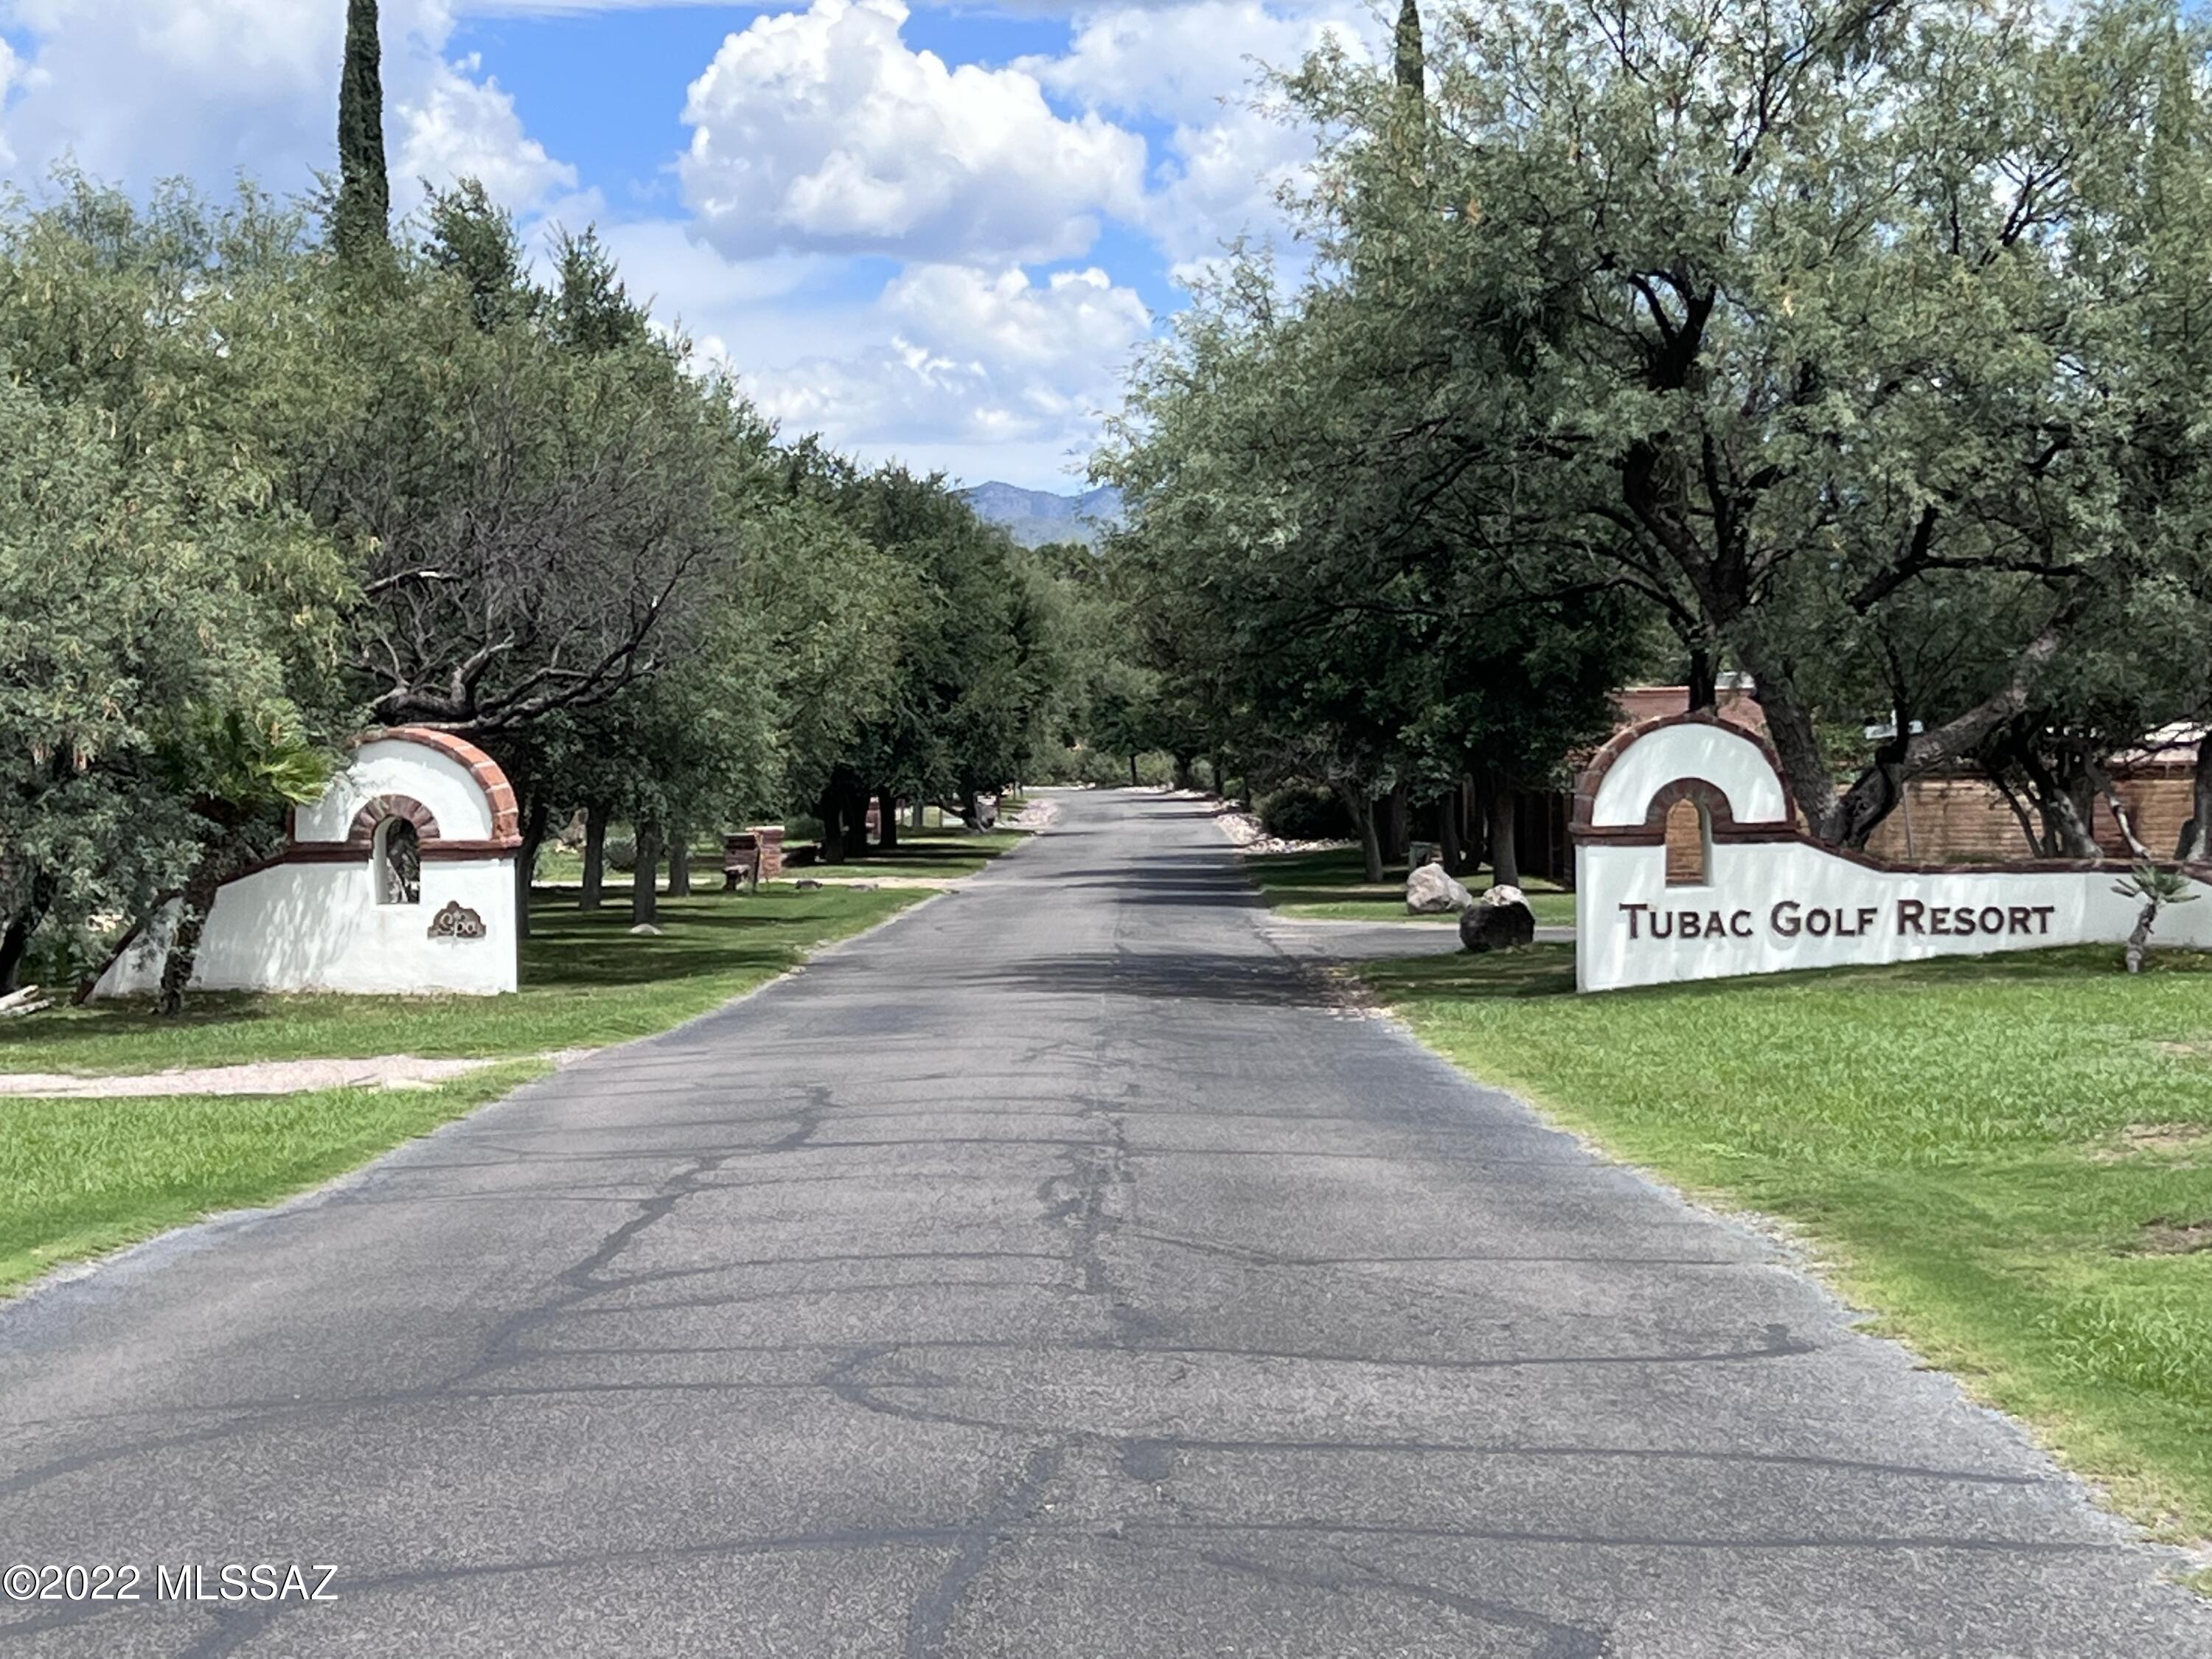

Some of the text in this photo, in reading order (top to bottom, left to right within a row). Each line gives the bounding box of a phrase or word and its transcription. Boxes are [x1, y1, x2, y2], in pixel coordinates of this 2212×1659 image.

[1619, 899, 2055, 939] TUBAC GOLF RESORT
